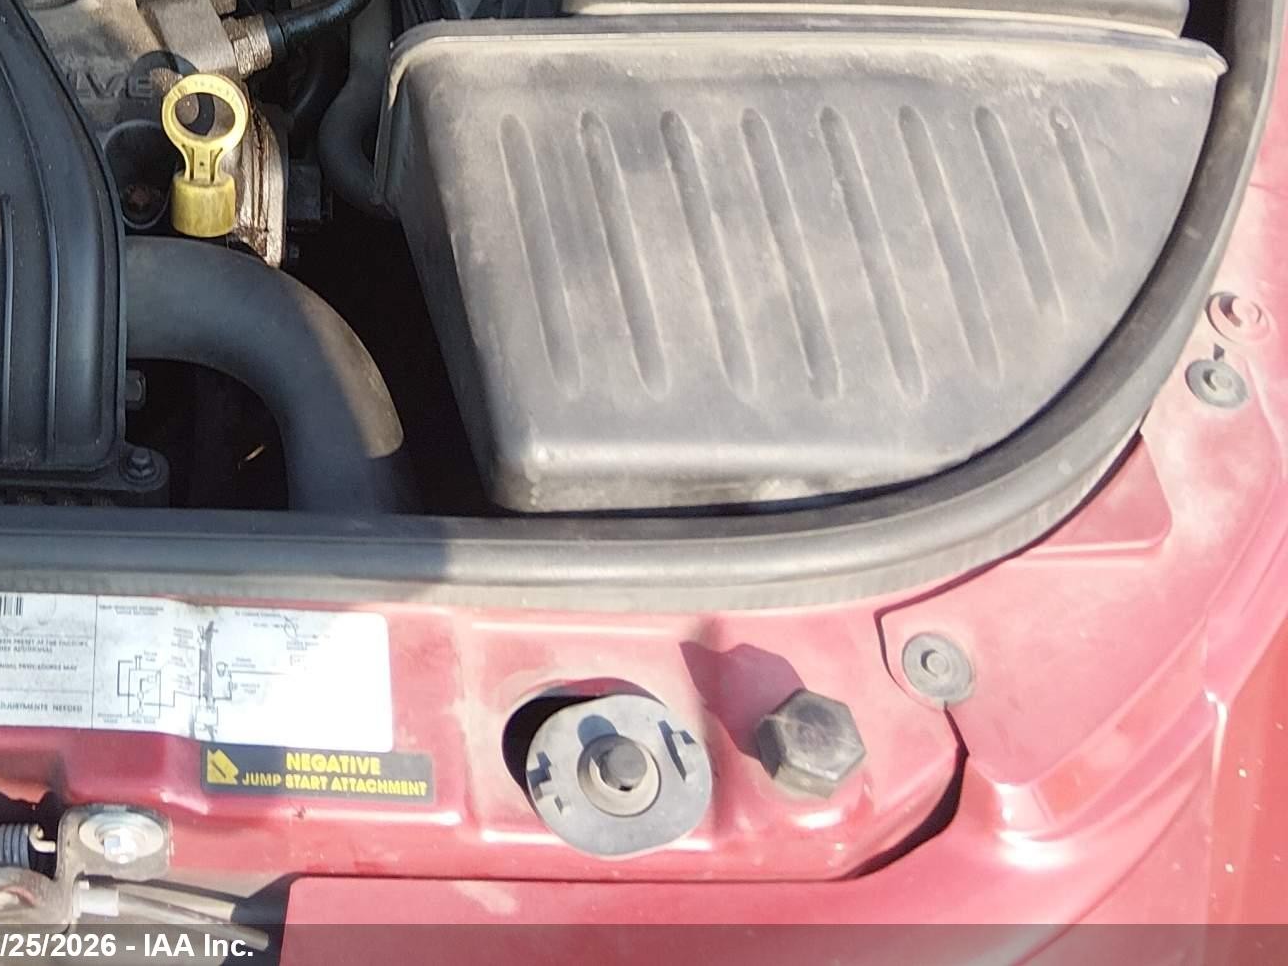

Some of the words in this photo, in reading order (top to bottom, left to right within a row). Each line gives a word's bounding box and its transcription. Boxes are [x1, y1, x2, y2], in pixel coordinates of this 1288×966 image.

[287, 753, 381, 775] NEGATIVE
[242, 772, 281, 787] JUMP
[285, 775, 329, 791] START
[331, 778, 427, 796] ATTACHMENT
